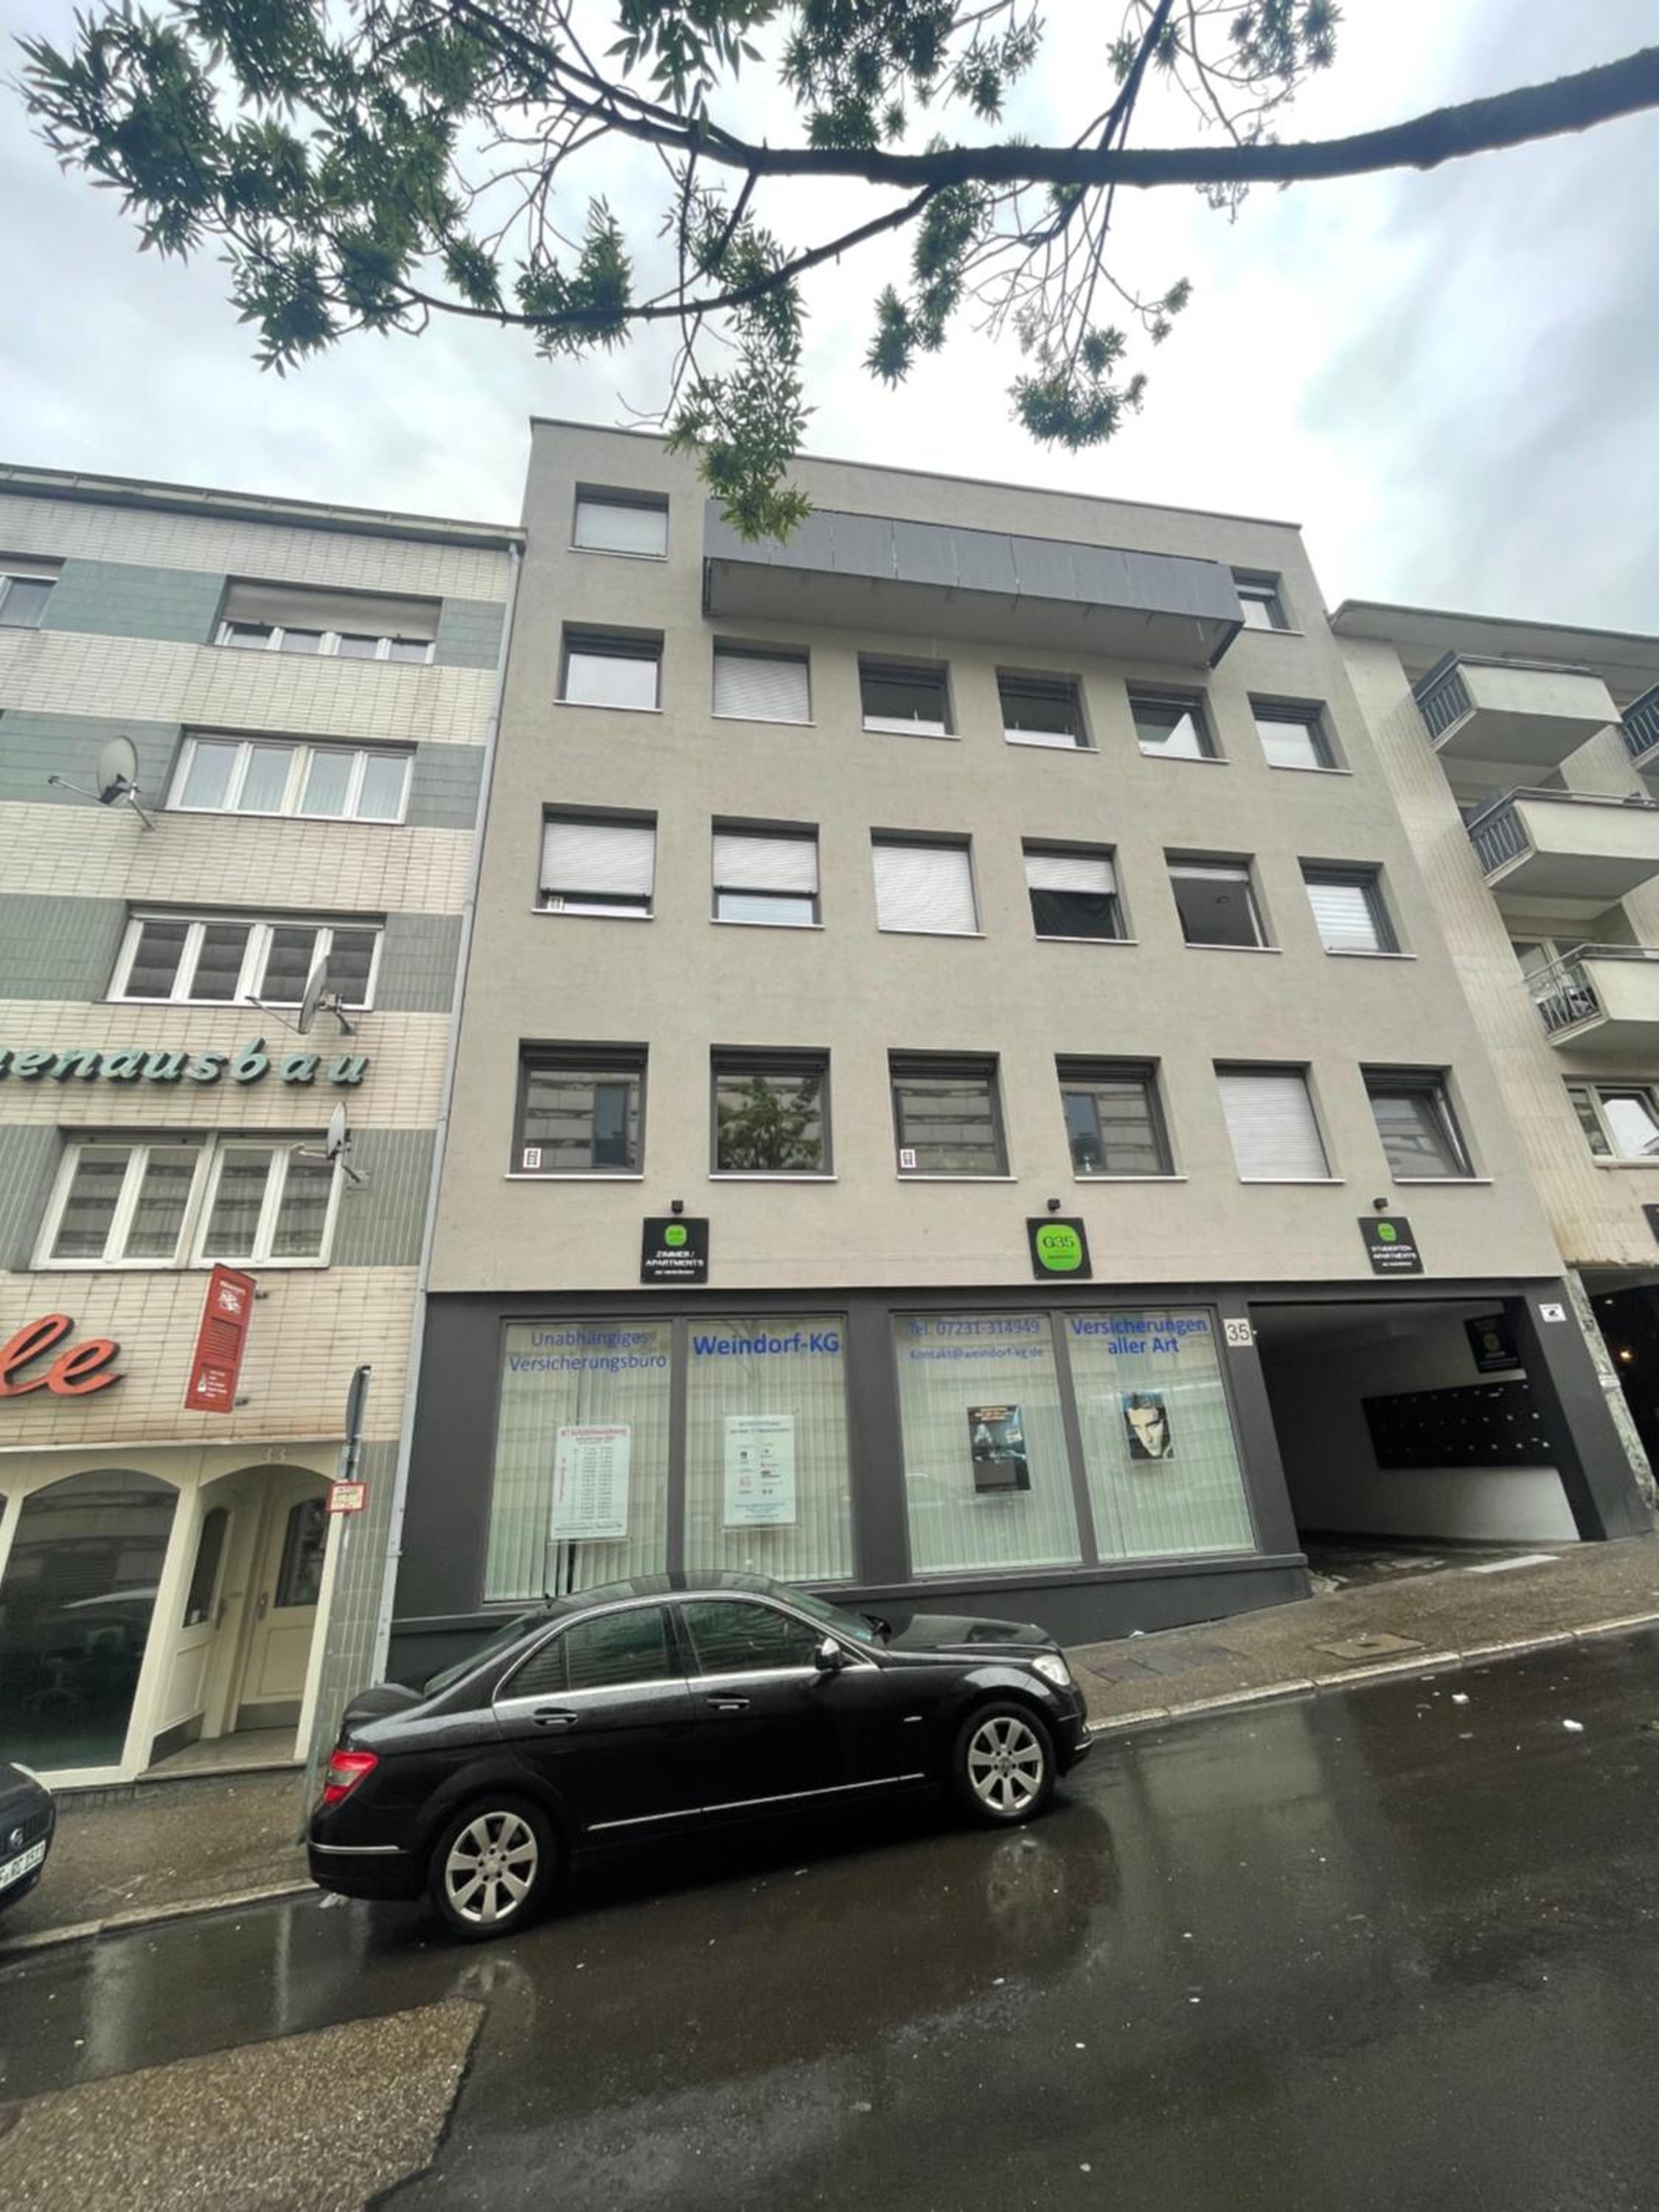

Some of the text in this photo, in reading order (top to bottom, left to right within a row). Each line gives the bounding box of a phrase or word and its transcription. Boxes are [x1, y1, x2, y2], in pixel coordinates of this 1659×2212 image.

[0, 1037, 369, 1082] enausbau
[1071, 1318, 1208, 1335] Versicherungen
[1226, 1324, 1250, 1341] 35
[692, 1332, 839, 1355] Weindorf-KG
[1108, 1337, 1180, 1354] aller Art
